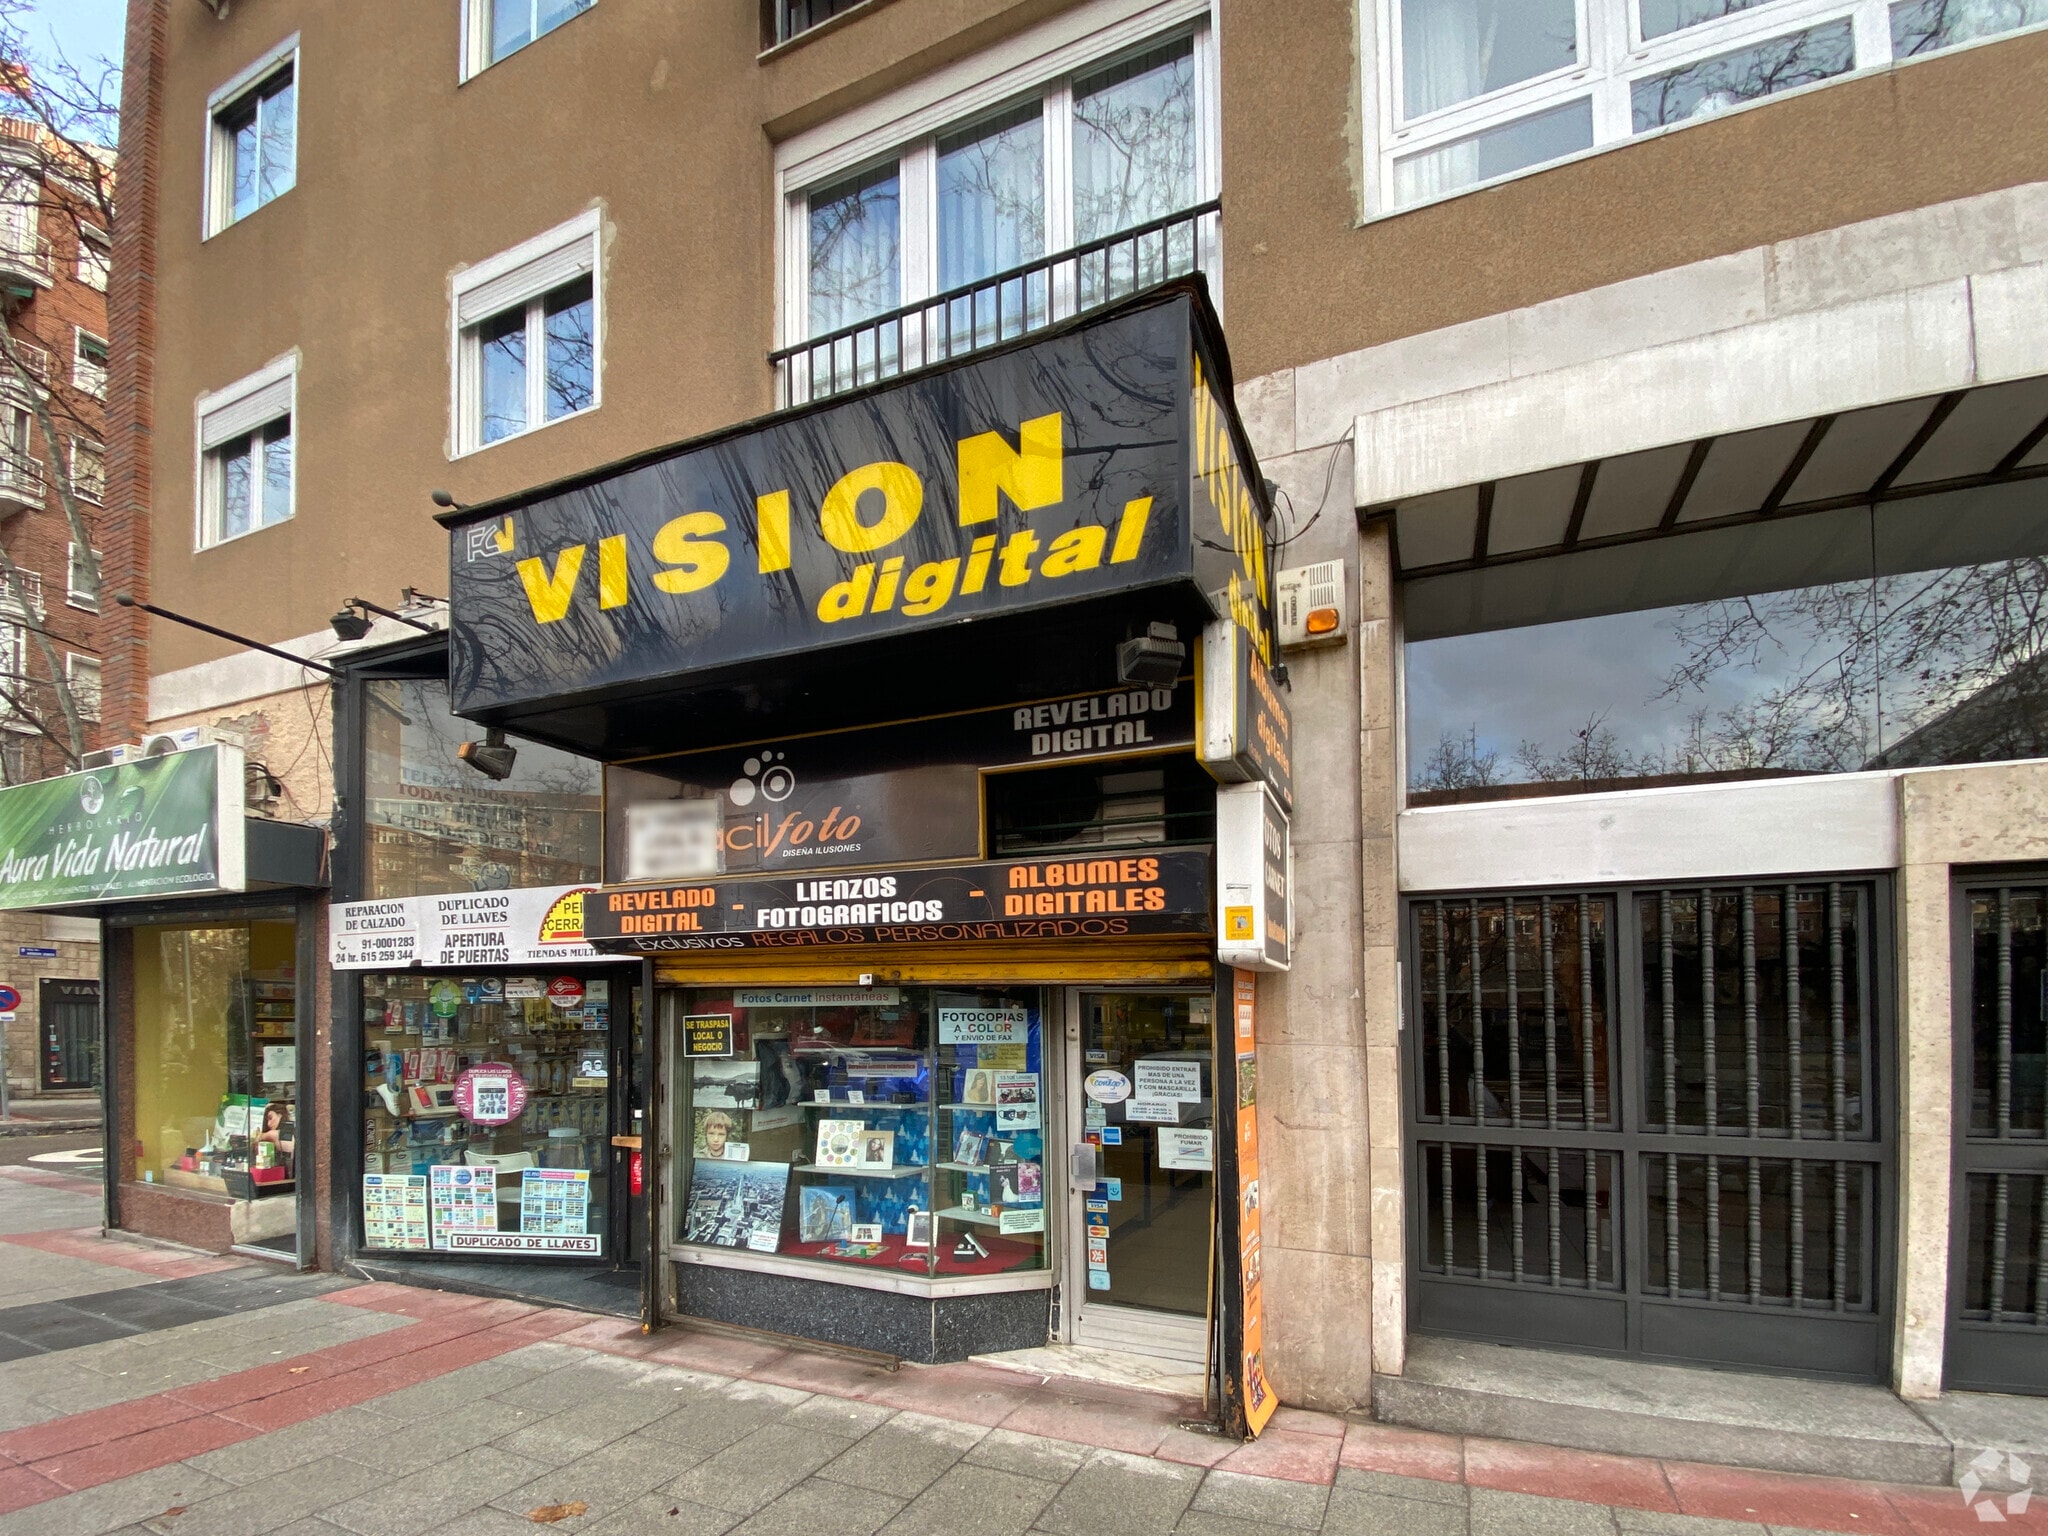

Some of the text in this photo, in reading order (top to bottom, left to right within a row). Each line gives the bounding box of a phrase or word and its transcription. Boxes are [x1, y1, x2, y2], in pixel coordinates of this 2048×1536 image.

[1194, 351, 1268, 612] VISION
[515, 412, 1063, 624] VISION
[816, 496, 1153, 623] digital
[1250, 649, 1289, 742] Albumes
[1013, 688, 1173, 731] REVELADO
[1031, 719, 1154, 756] DIGITAL
[1257, 709, 1290, 779] digitales
[397, 780, 455, 803] TODAS
[49, 812, 143, 836] HERBOLARIO
[716, 806, 862, 858] cilfoto
[1264, 812, 1281, 861] OTOS
[0, 823, 209, 884] Aura Vida Natural
[782, 843, 862, 858] DISEÑA ILUSIONES
[175, 872, 216, 884] ECOLOGICA
[1009, 857, 1159, 889] ALBUMES
[796, 876, 897, 902] LIENZOS
[438, 896, 510, 912] DUPLICADO
[608, 887, 716, 912] REVELADO
[1004, 886, 1166, 917] DIGITALES
[345, 903, 405, 917] REPARACION
[442, 911, 508, 925] DE LLAVES
[757, 898, 943, 929] FOTOGRAFICOS
[346, 917, 406, 931] DE CALZADO
[620, 912, 703, 934] DIGITAL
[361, 936, 415, 949] 91-0001283
[444, 931, 506, 949] APERTURA
[634, 918, 1129, 952] Exclusivos REGALOS PERSONALIZADOS
[336, 950, 413, 963] 24 hr. 615 259 344
[440, 947, 510, 965] DE PUERTAS
[527, 949, 567, 958] TIENDAS
[741, 991, 889, 1003] Fotos Carnet Instantáneas
[686, 1020, 730, 1029] SE TRASPASA
[942, 1013, 1024, 1022] FOTOCOPIAS
[693, 1032, 723, 1040] LOCAL O
[953, 1023, 1013, 1033] A COLOR
[693, 1043, 723, 1052] NEGOCIO
[1174, 1133, 1209, 1141] PROHIBIDO
[456, 1236, 591, 1249] DUPLICADO DE LLAVES
